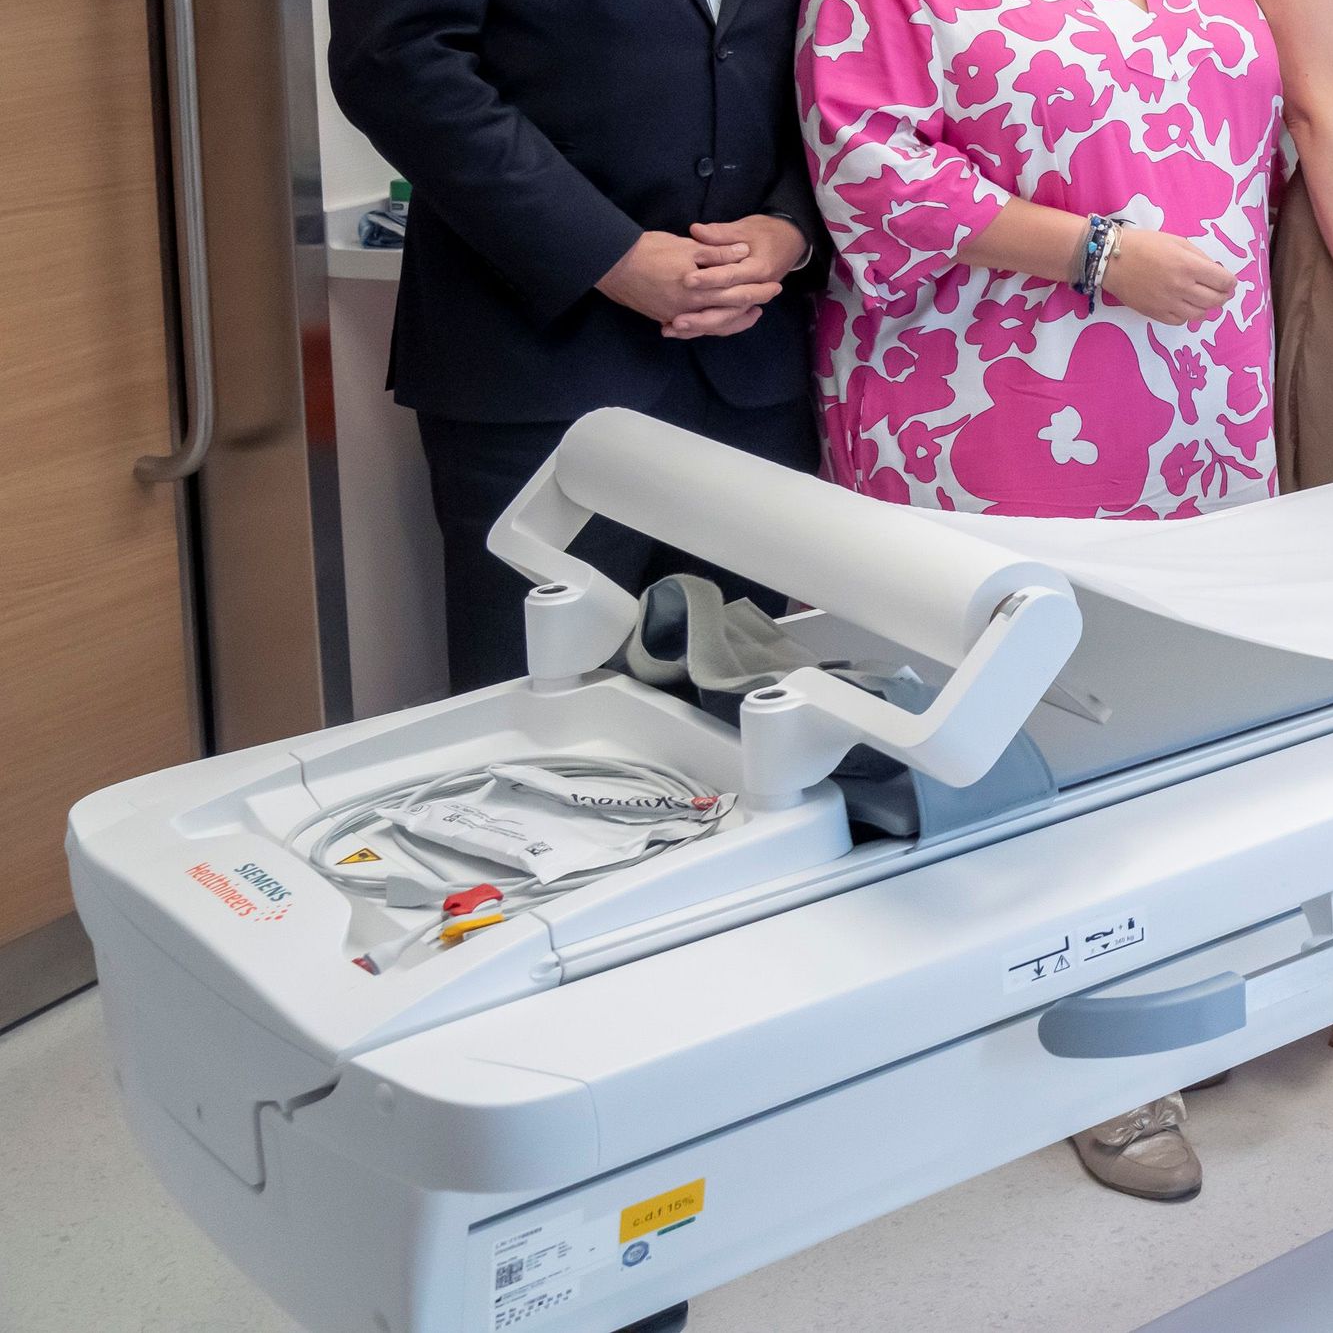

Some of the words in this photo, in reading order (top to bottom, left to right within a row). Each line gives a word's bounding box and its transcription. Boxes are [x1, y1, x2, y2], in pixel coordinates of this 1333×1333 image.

[184, 861, 257, 917] Healthineers
[234, 862, 292, 902] SIEMENS
[667, 1195, 695, 1213] 15%
